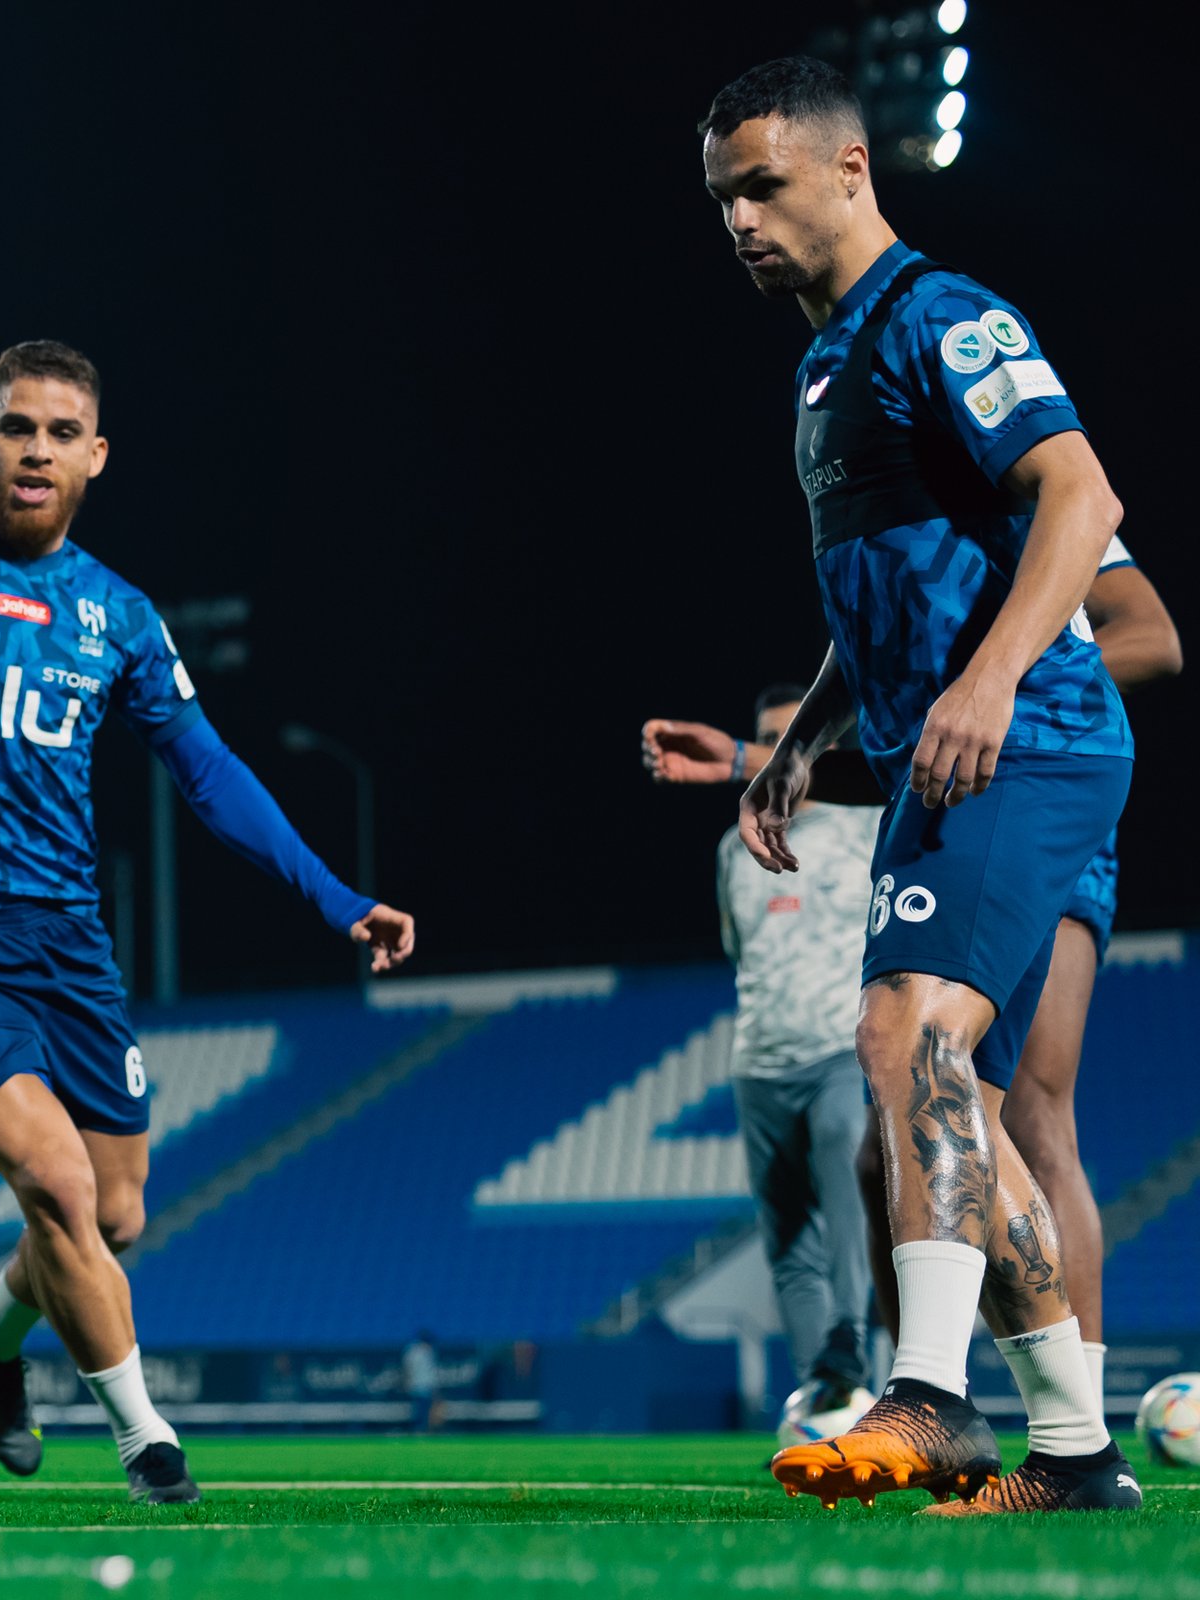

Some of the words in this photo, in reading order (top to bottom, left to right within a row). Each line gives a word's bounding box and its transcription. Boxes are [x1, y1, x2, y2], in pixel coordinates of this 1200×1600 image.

[42, 667, 102, 694] STORE
[870, 873, 895, 936] 6
[125, 1045, 147, 1098] 6
